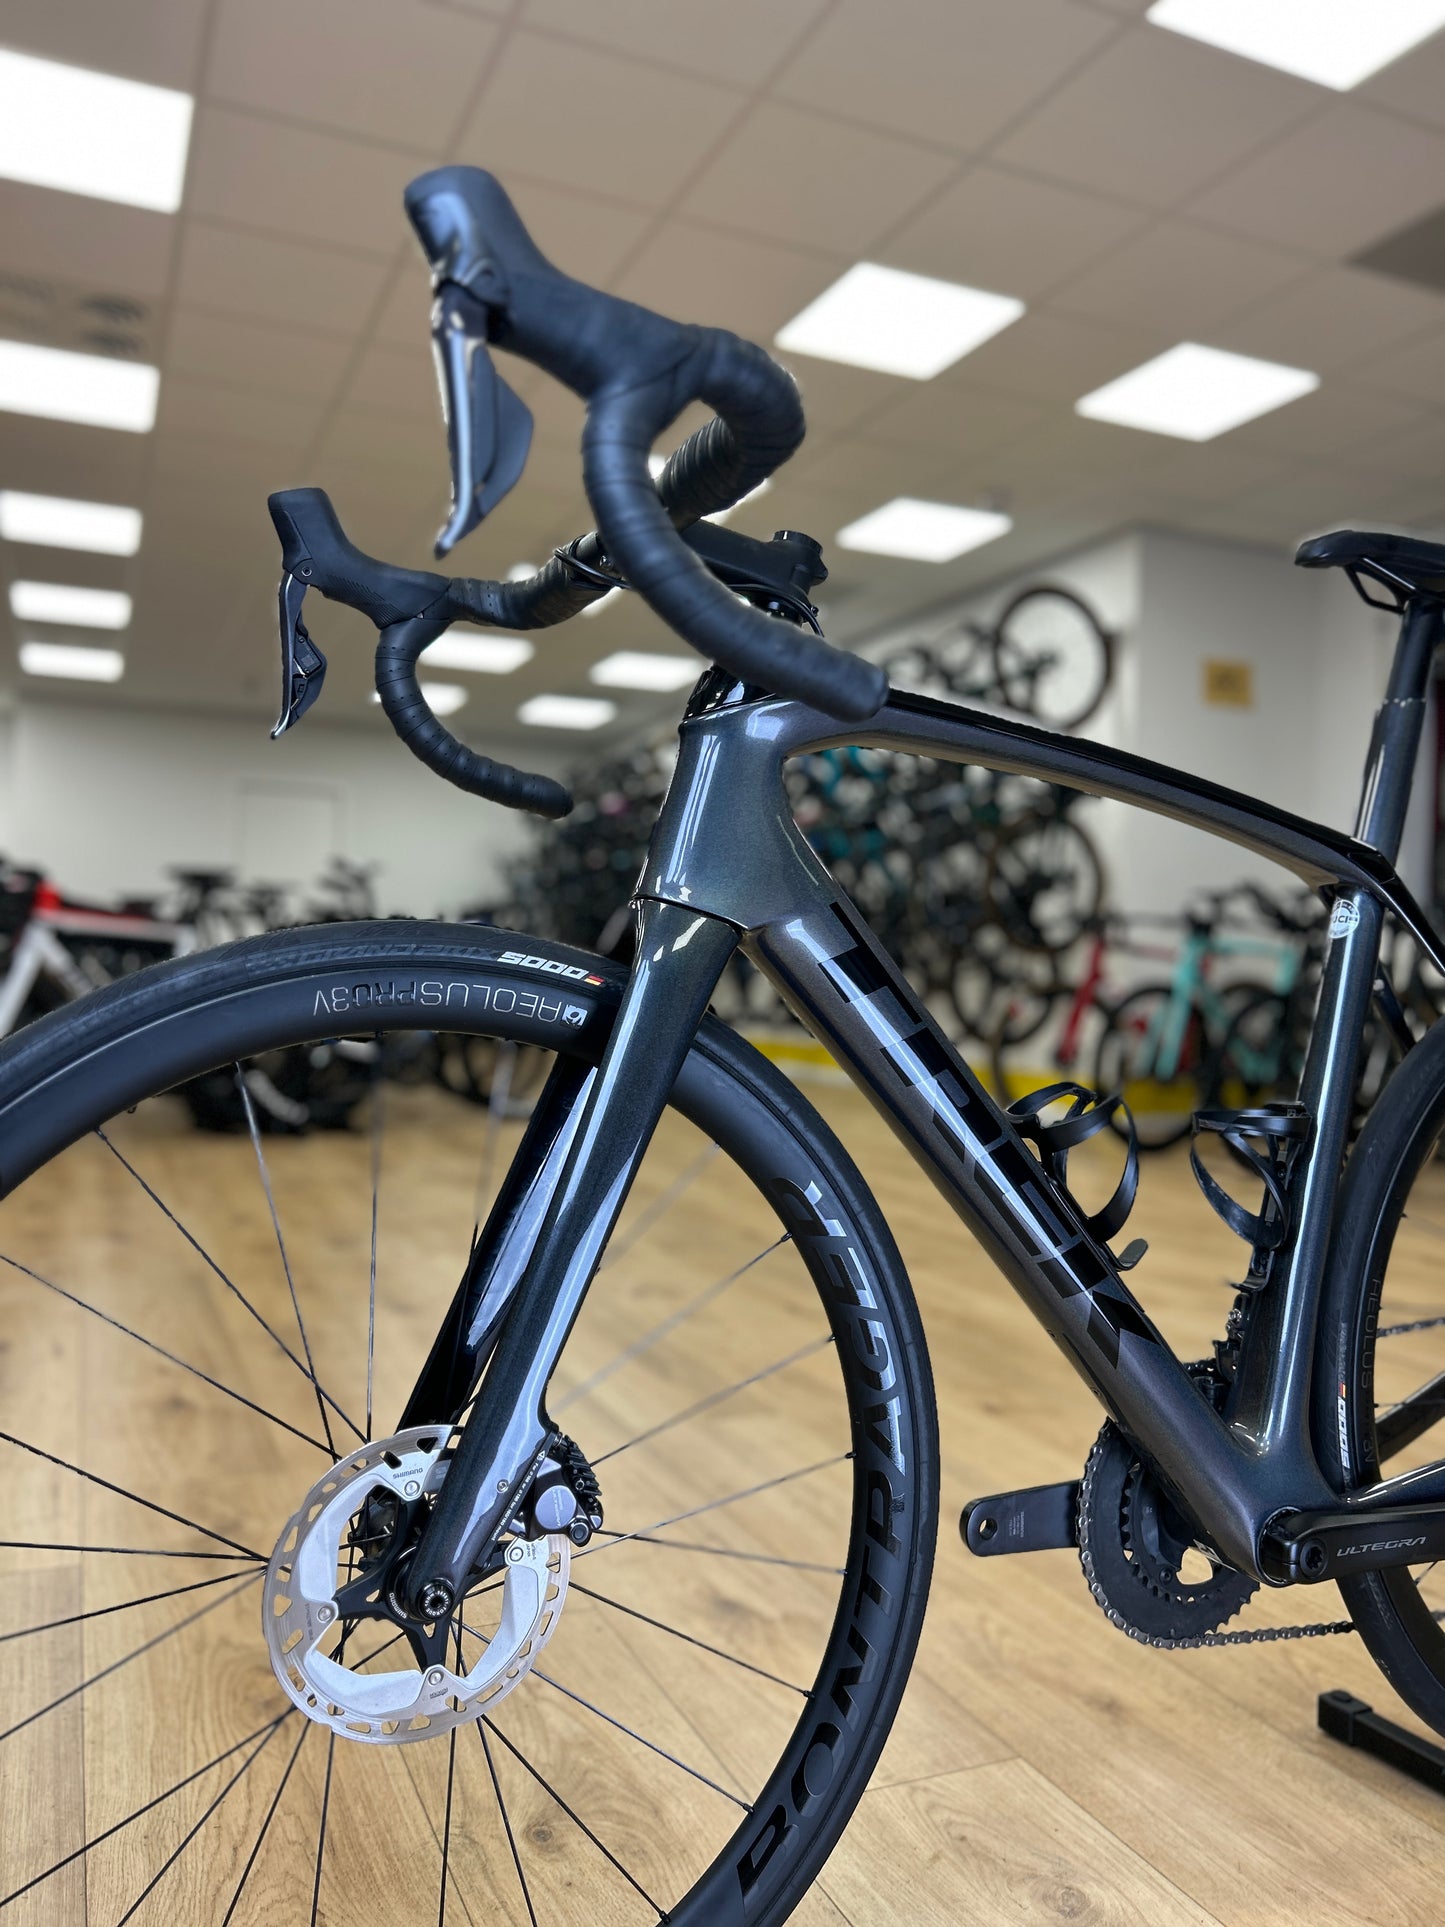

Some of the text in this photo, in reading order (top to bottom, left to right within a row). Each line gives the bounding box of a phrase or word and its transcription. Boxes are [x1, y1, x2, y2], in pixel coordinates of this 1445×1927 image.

[498, 951, 588, 980] 5000
[1337, 1396, 1351, 1468] 5000
[736, 1177, 906, 1910] BONTRAGER
[1336, 1536, 1427, 1557] ULTEGRA
